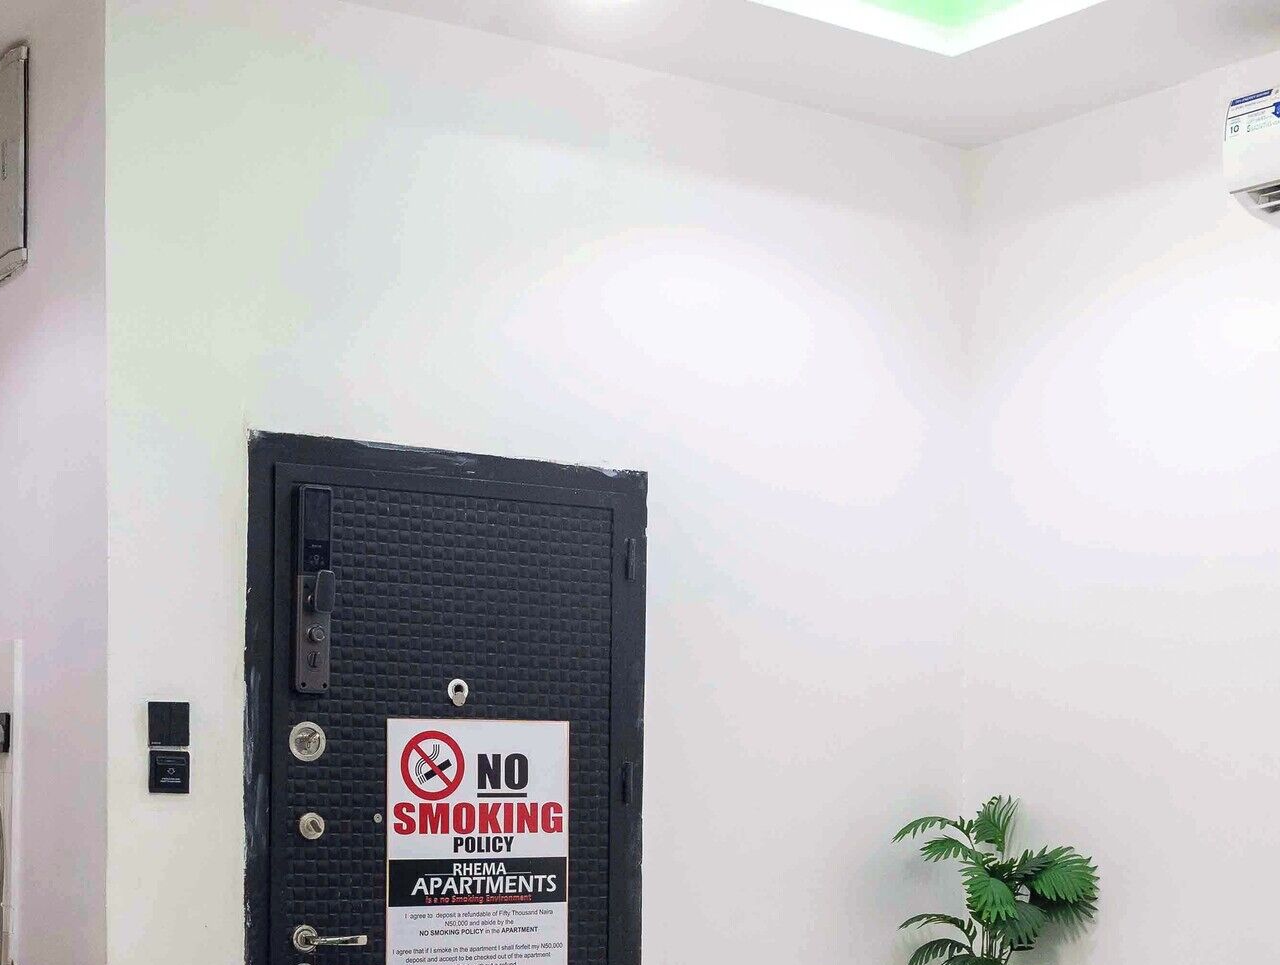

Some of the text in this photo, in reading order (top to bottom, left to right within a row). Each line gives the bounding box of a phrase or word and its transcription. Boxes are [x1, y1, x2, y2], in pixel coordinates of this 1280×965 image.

[477, 753, 529, 790] NO
[393, 802, 564, 835] SMOKING
[453, 836, 514, 853] POLICY
[453, 862, 507, 876] RHEMA
[411, 874, 557, 896] APARTMENTS
[452, 894, 484, 904] Smoking
[486, 893, 532, 902] Environment
[410, 912, 426, 920] agree
[435, 911, 457, 920] deposit
[462, 910, 491, 918] refundable
[420, 929, 429, 937] NO
[501, 926, 538, 934] APARTMENT
[396, 948, 412, 956] agree
[469, 945, 497, 953] apartment
[524, 951, 551, 959] apartment
